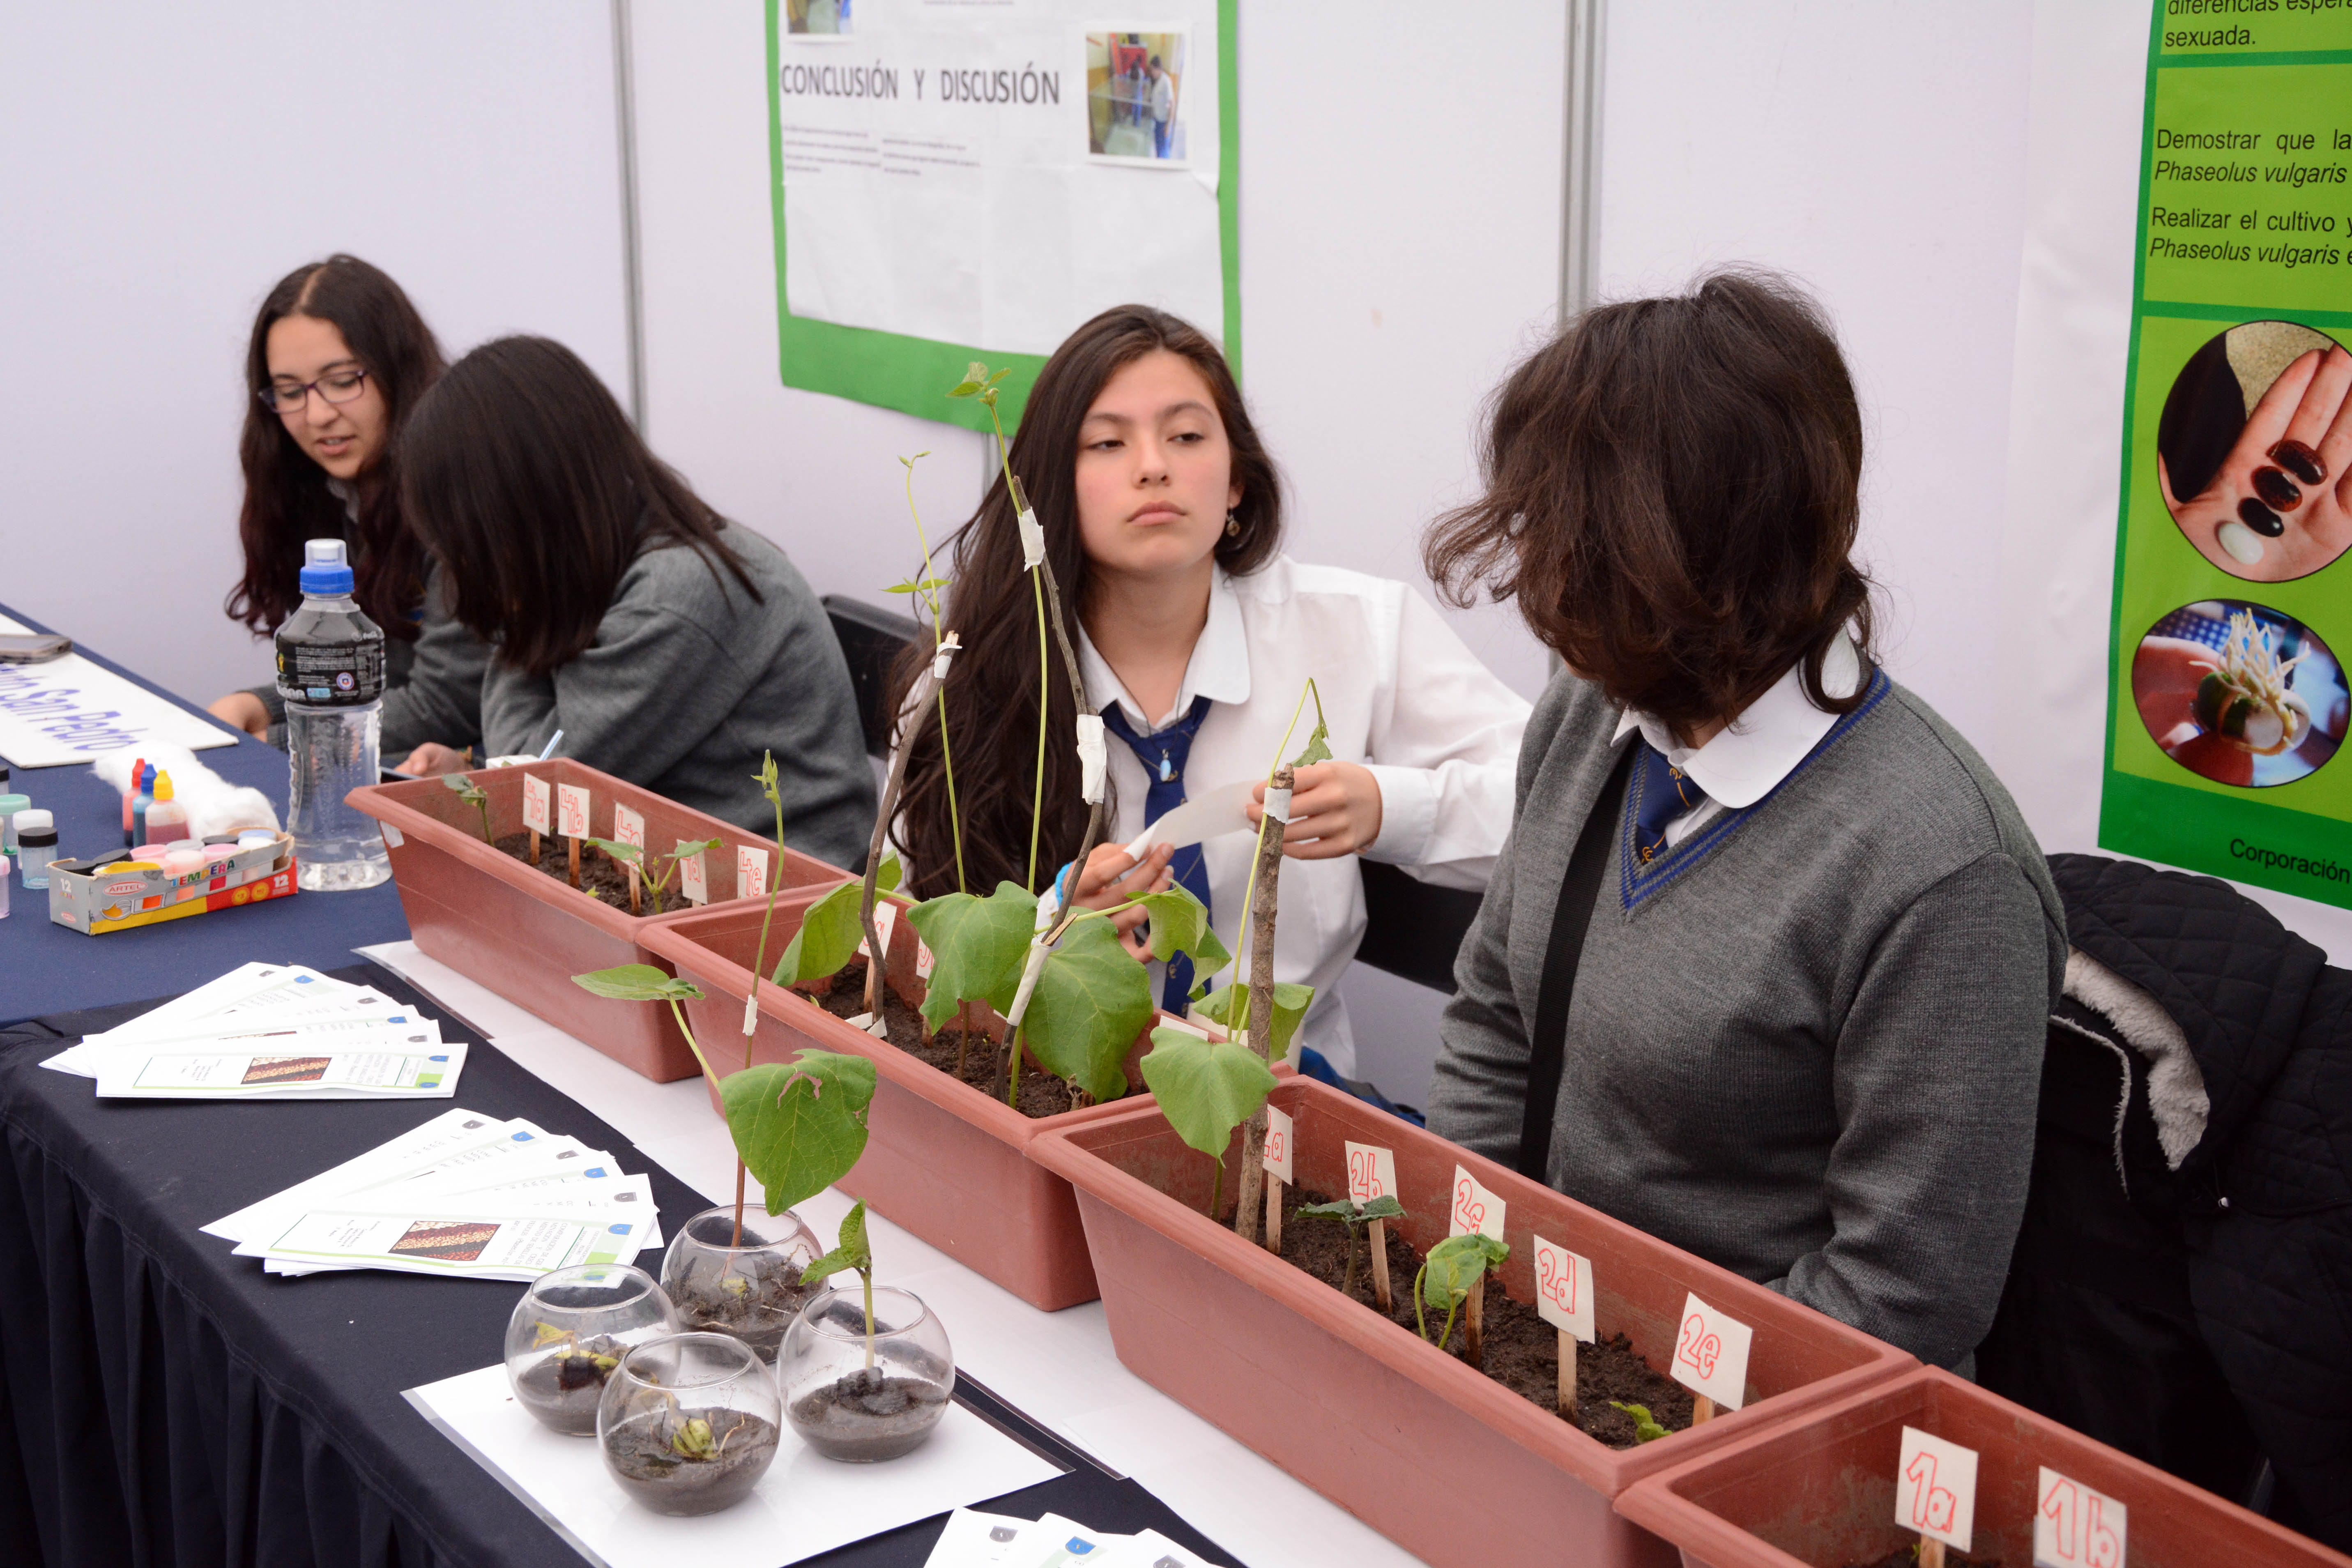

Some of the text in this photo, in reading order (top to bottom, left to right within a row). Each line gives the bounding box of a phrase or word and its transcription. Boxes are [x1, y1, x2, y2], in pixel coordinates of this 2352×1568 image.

[2165, 25, 2256, 47] sexuada.
[782, 59, 1060, 105] CONCLUSIÓN Y DISCUSIÓN
[2157, 129, 2352, 154] Demostrar que la
[2154, 161, 2347, 188] Phaseolus vulgaris
[2152, 207, 2231, 229] Realizar
[2240, 210, 2256, 229] el
[2267, 211, 2335, 233] cultivo
[2149, 238, 2251, 261] Phaseolus
[2258, 244, 2340, 269] vulgaris
[0, 689, 149, 750] San Pedro
[526, 781, 545, 823] 4a
[560, 788, 583, 834] 4b
[171, 859, 235, 887] TEMPERA
[273, 874, 289, 887] 12
[739, 851, 762, 896] 4e
[2230, 838, 2350, 883] Corporación
[60, 877, 72, 893] 12
[109, 884, 143, 893] ARTEL
[1538, 1248, 1576, 1315] 2d
[1678, 1313, 1721, 1380] 2e
[1906, 1451, 1956, 1533] 1a
[2041, 1478, 2120, 1568] 1b
